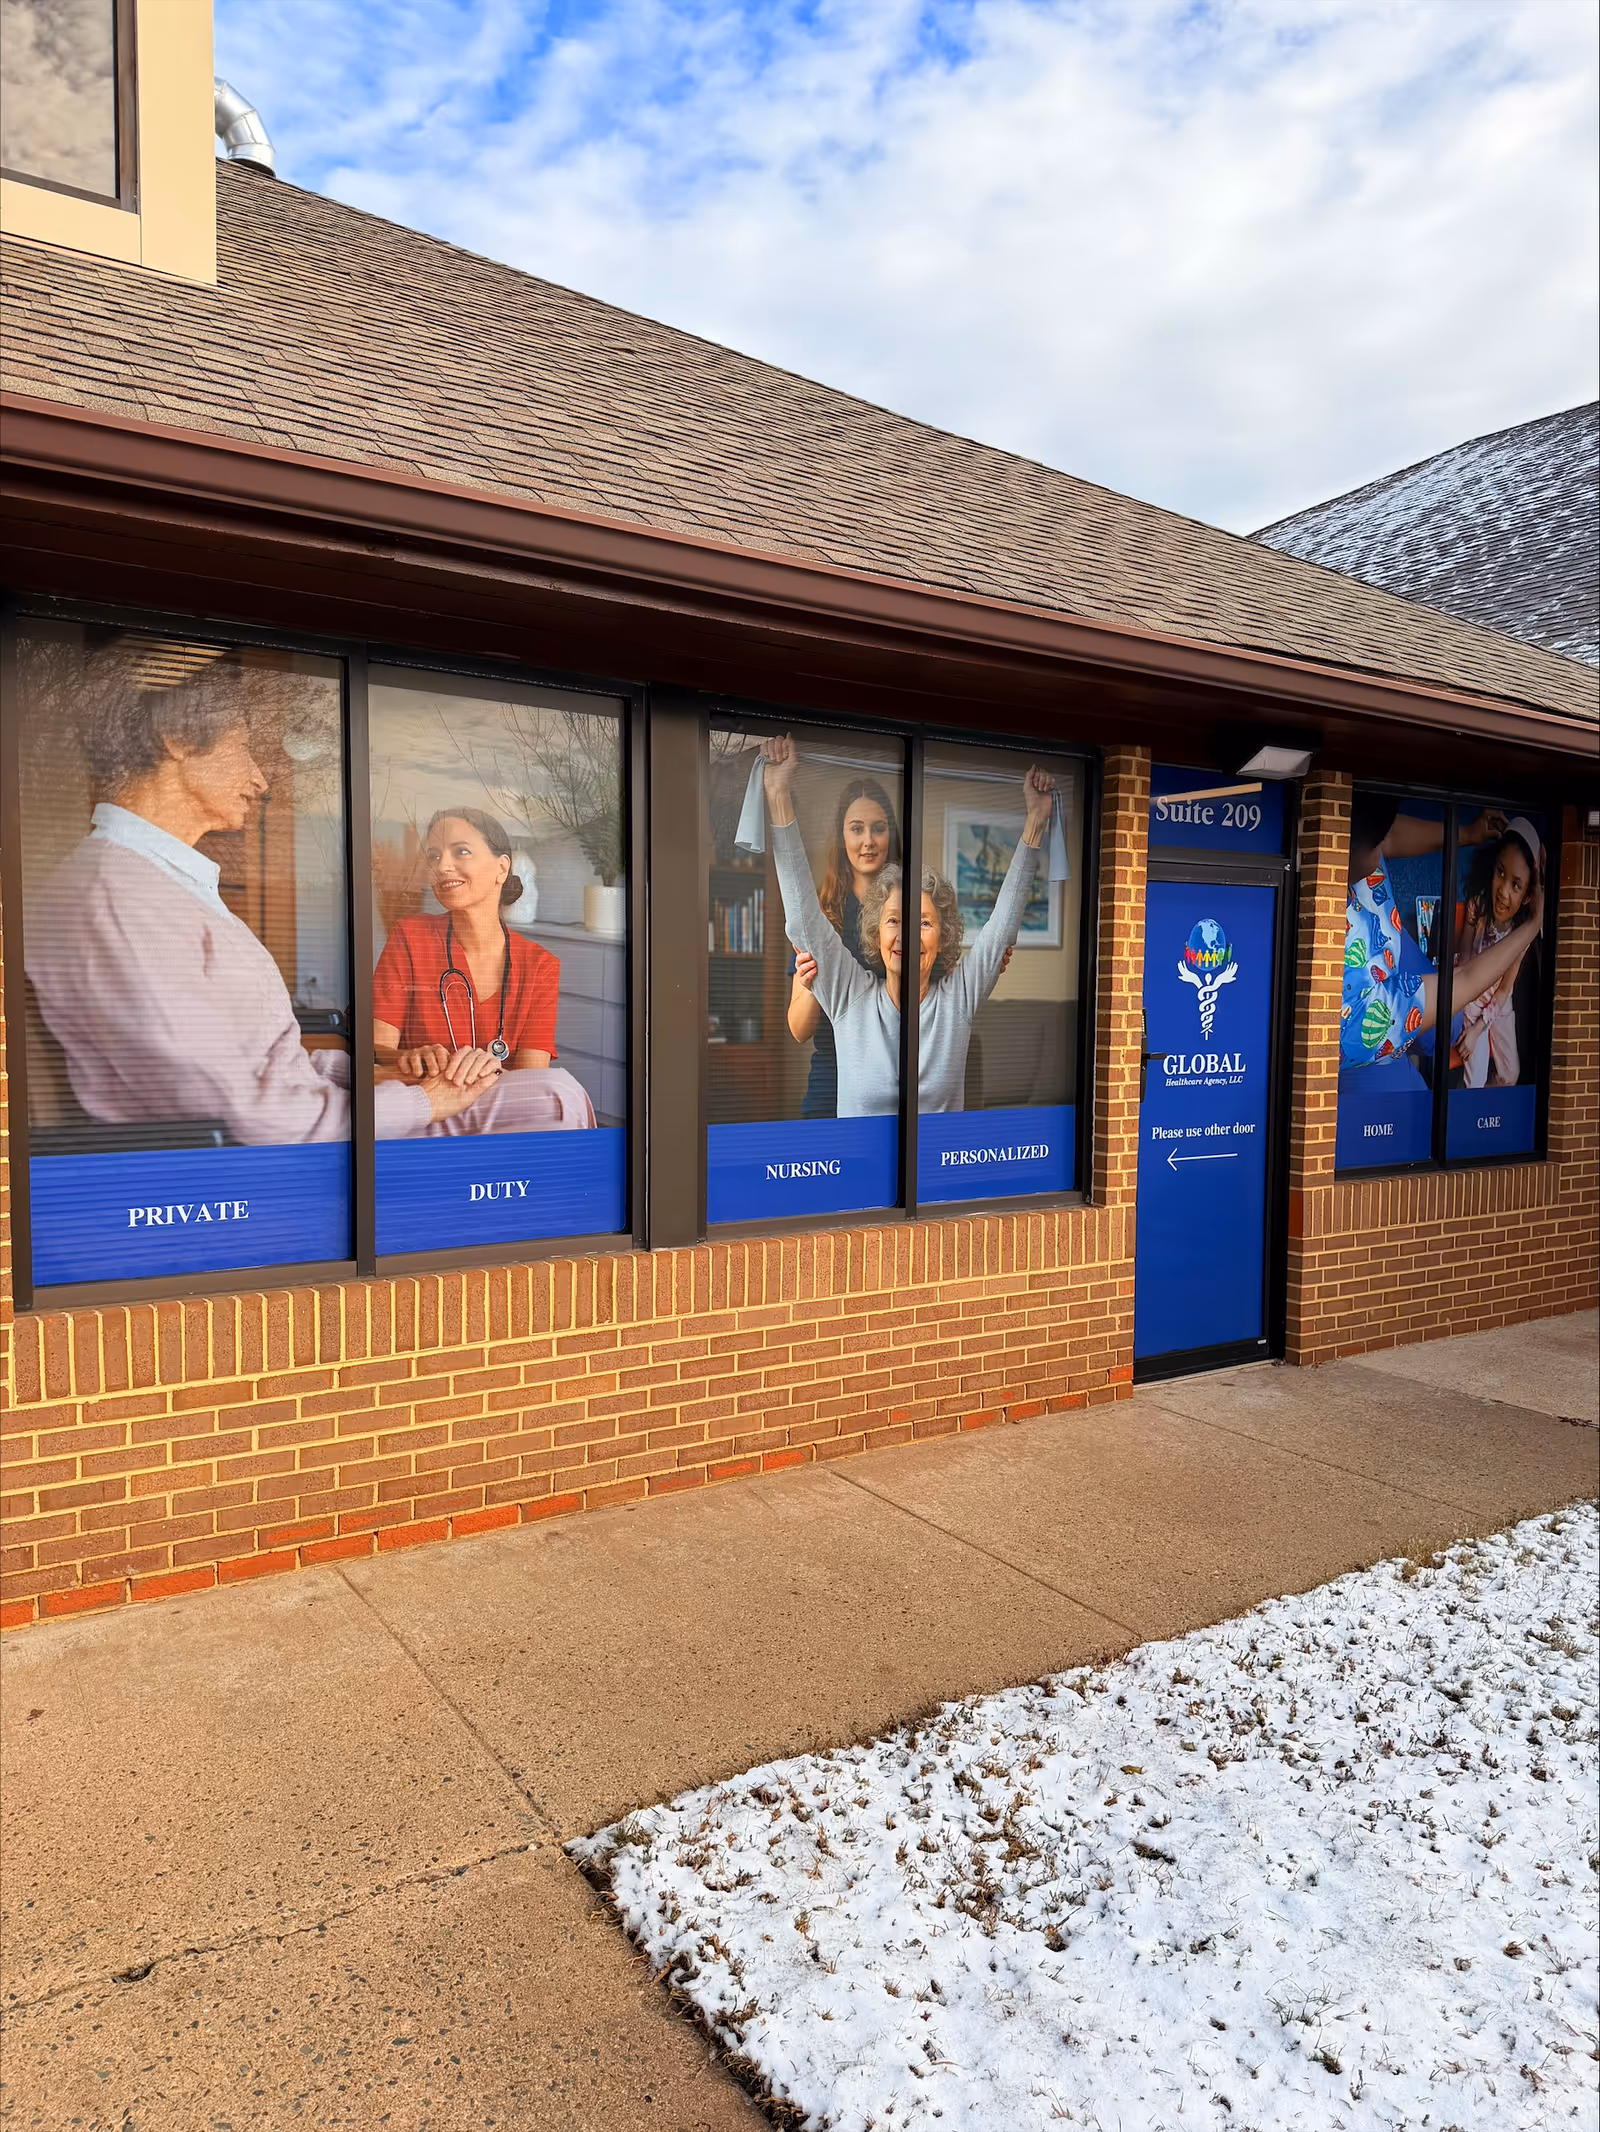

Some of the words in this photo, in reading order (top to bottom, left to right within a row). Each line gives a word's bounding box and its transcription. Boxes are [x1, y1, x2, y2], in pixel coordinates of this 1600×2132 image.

[1155, 796, 1215, 826] Suite
[1221, 802, 1262, 832] 209
[1163, 1053, 1246, 1076] GLOBAL
[1165, 1077, 1202, 1087] Healthcare
[1203, 1077, 1228, 1087] Agency,
[1229, 1075, 1244, 1084] LLC
[1152, 1126, 1184, 1140] Please
[1186, 1127, 1203, 1138] use
[1204, 1122, 1231, 1137] other
[1233, 1121, 1256, 1135] door
[1363, 1123, 1394, 1137] HOME
[1477, 1116, 1501, 1129] CARE
[940, 1144, 1050, 1167] PERSONALIZED
[765, 1159, 842, 1180] NURSING
[469, 1180, 531, 1202] DUTY
[127, 1200, 250, 1228] PRIVATE
